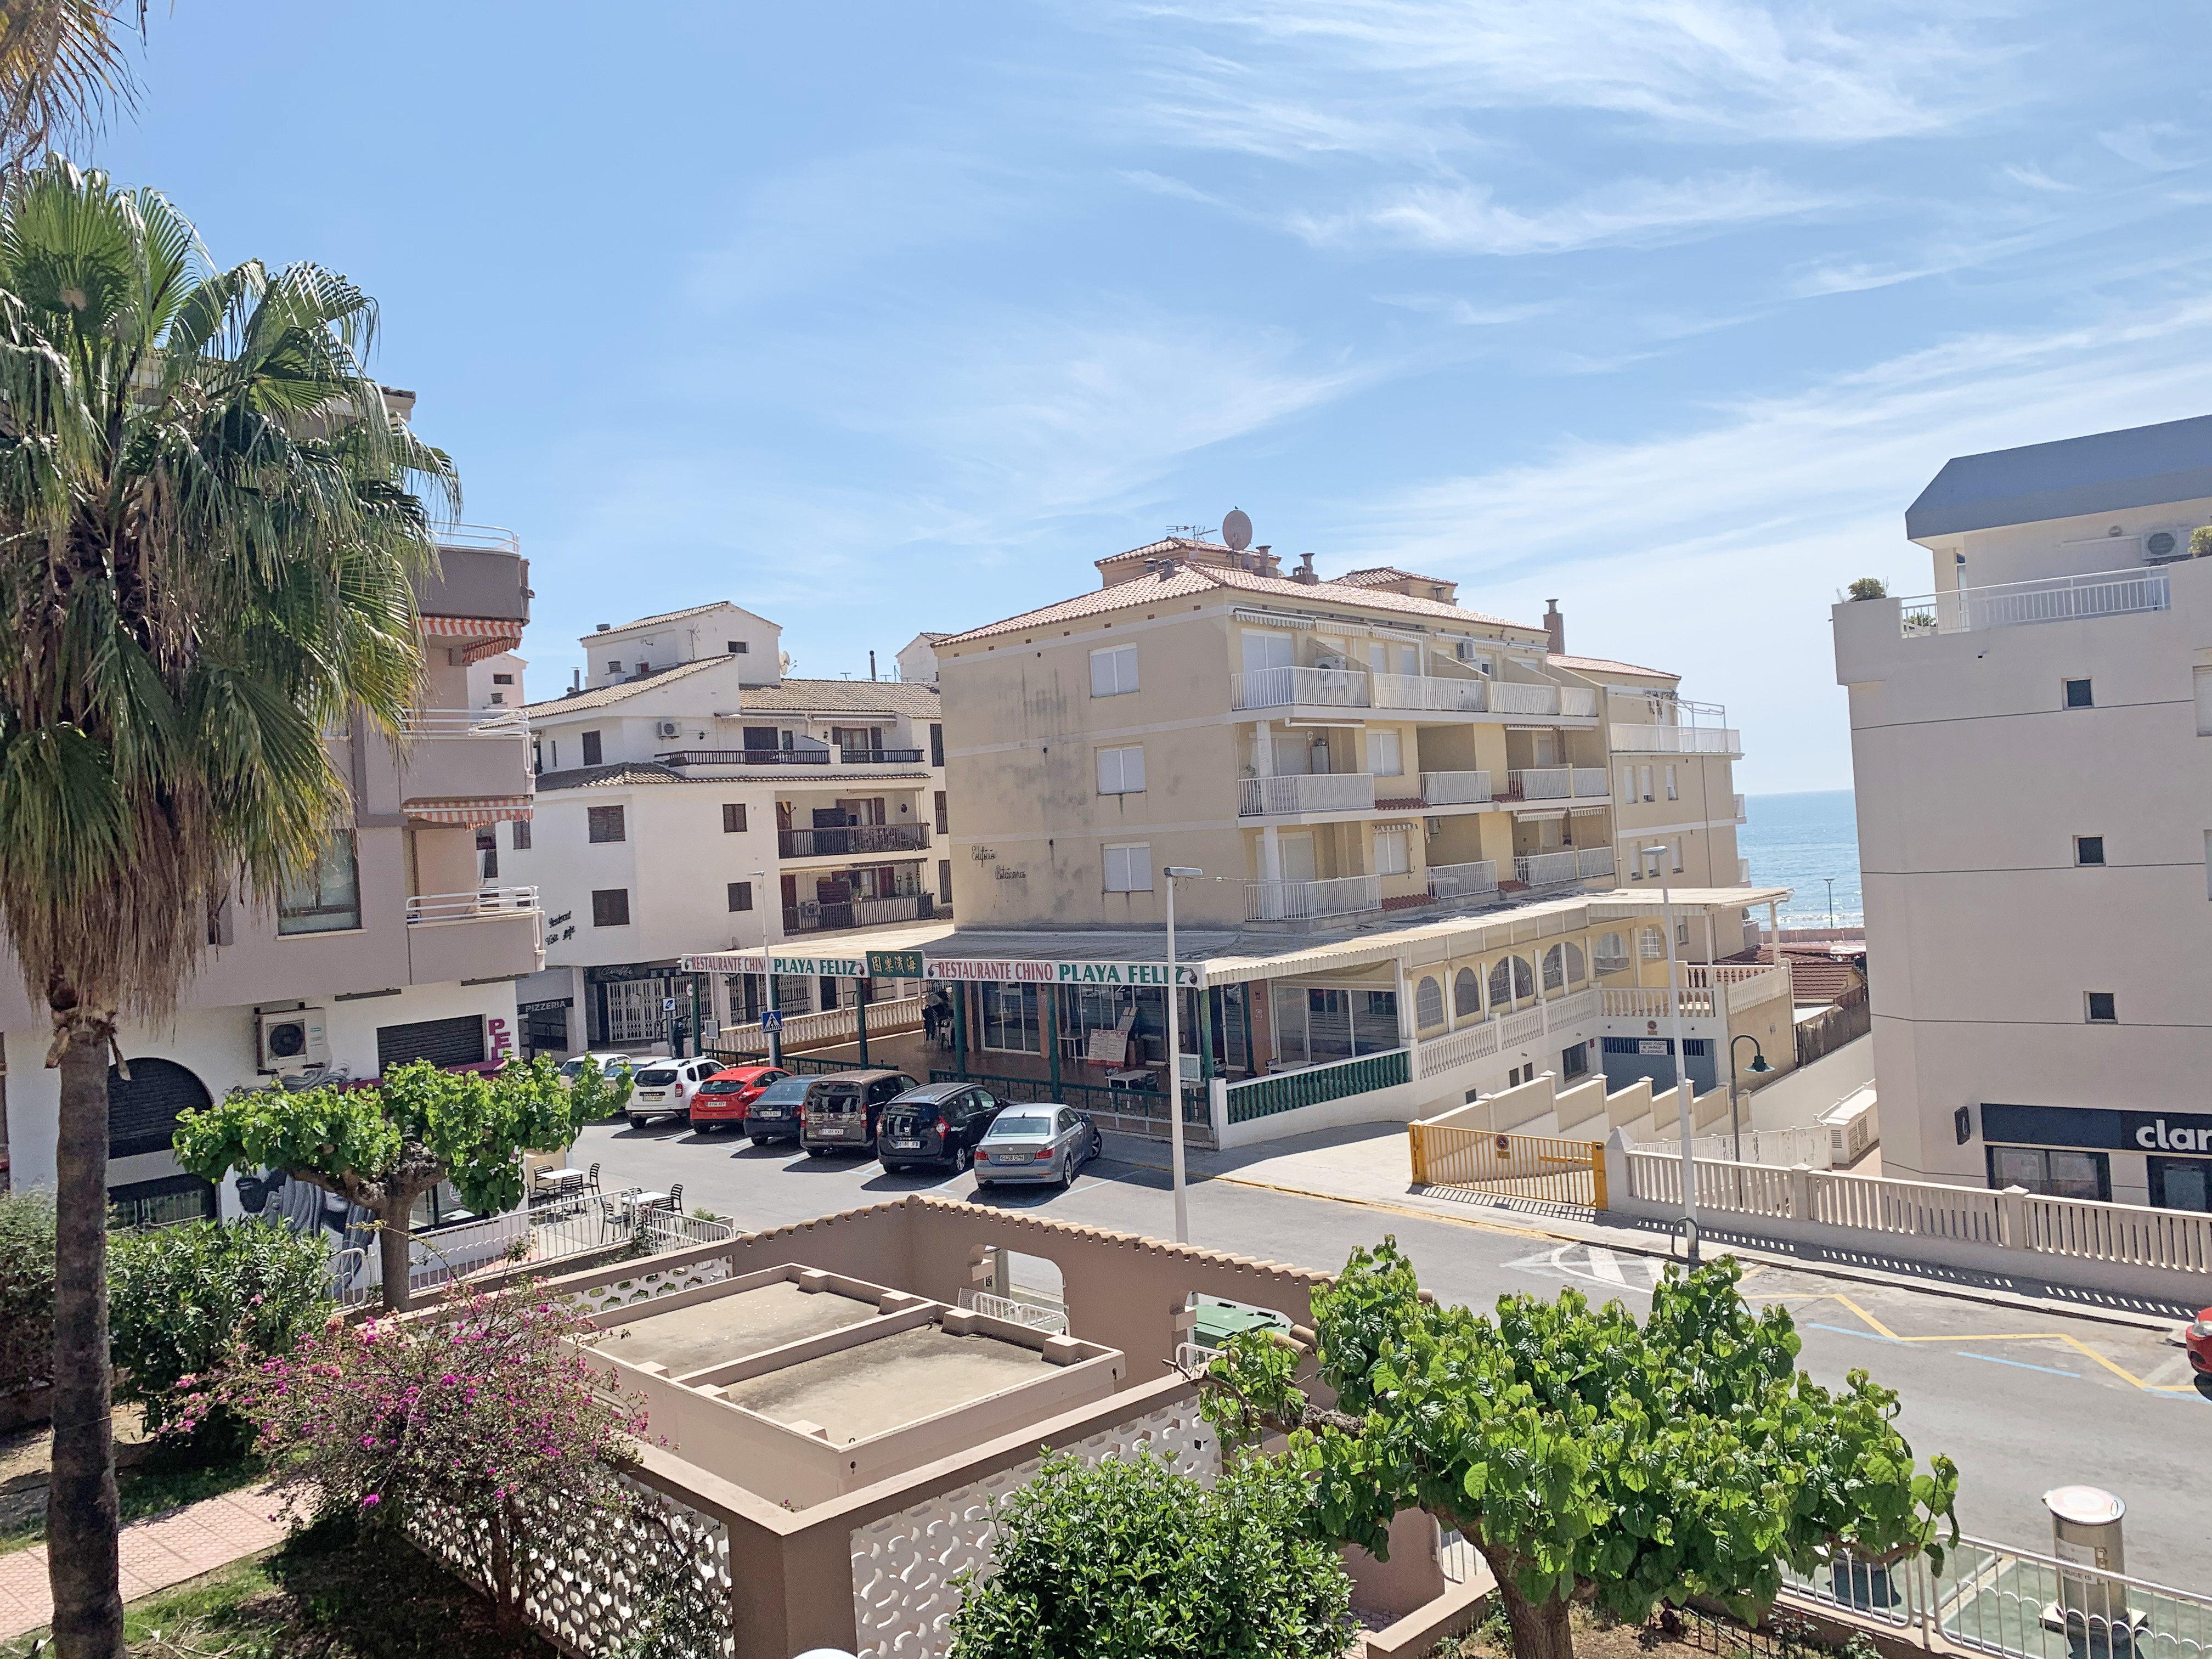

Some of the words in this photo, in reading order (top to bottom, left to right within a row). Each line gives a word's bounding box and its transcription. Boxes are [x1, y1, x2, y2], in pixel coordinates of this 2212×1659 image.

[972, 845, 995, 867] Edificio
[692, 956, 742, 972] RESTAURANTE
[744, 957, 766, 972] CHIN
[774, 958, 815, 974] PLAYA
[820, 960, 857, 975] FELIZ
[939, 962, 1011, 980] RESTAURANTE
[1015, 963, 1053, 980] CHINO
[1059, 964, 1121, 983] PLAYA
[1128, 965, 1186, 985] FELIZ
[526, 1000, 566, 1013] PIZZERIA
